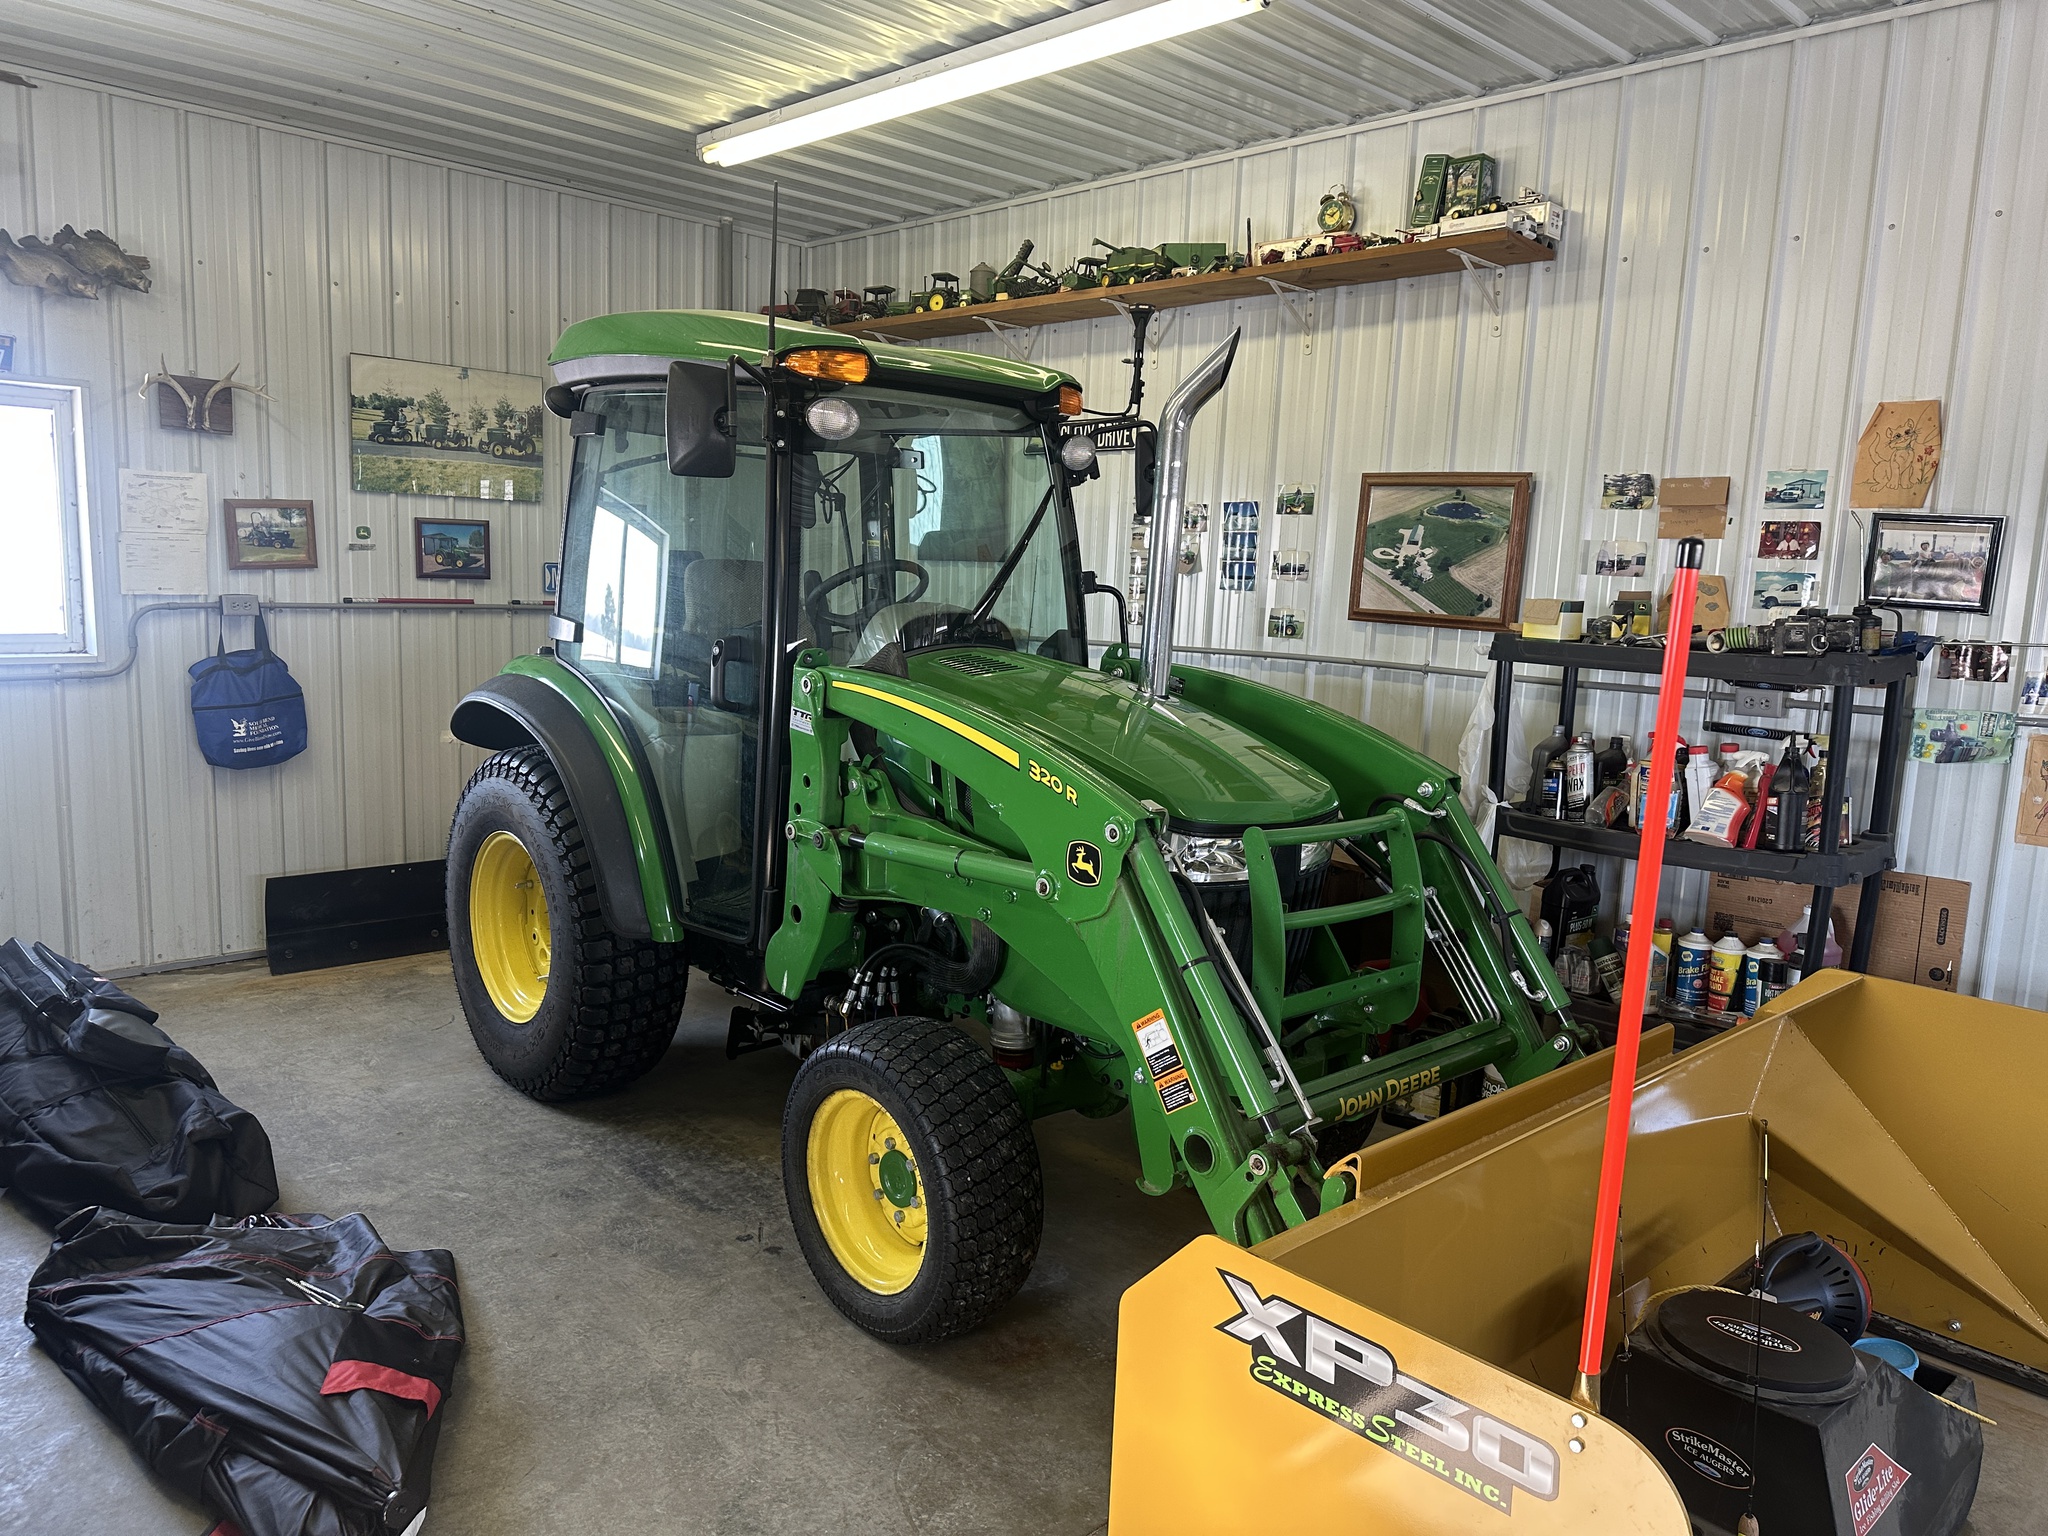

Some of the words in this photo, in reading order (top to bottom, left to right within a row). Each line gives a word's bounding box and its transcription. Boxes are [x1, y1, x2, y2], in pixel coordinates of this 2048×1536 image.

[1028, 759, 1063, 794] 320
[1066, 784, 1079, 807] R
[1678, 966, 1700, 975] Brake
[1746, 978, 1757, 986] Bra
[1141, 1012, 1161, 1027] WARNING
[1163, 1072, 1185, 1085] WARNING
[1335, 1087, 1383, 1122] JOHN
[1385, 1065, 1441, 1102] DEERE
[1251, 1354, 1366, 1430] EXPRESS
[1365, 1414, 1450, 1479] STEEL
[1453, 1466, 1508, 1508] INC.
[1671, 1430, 1750, 1478] StrikeMaster
[1683, 1443, 1699, 1457] ICE
[1699, 1453, 1735, 1476] AUGERS
[1854, 1465, 1894, 1522] Glide-Lite
